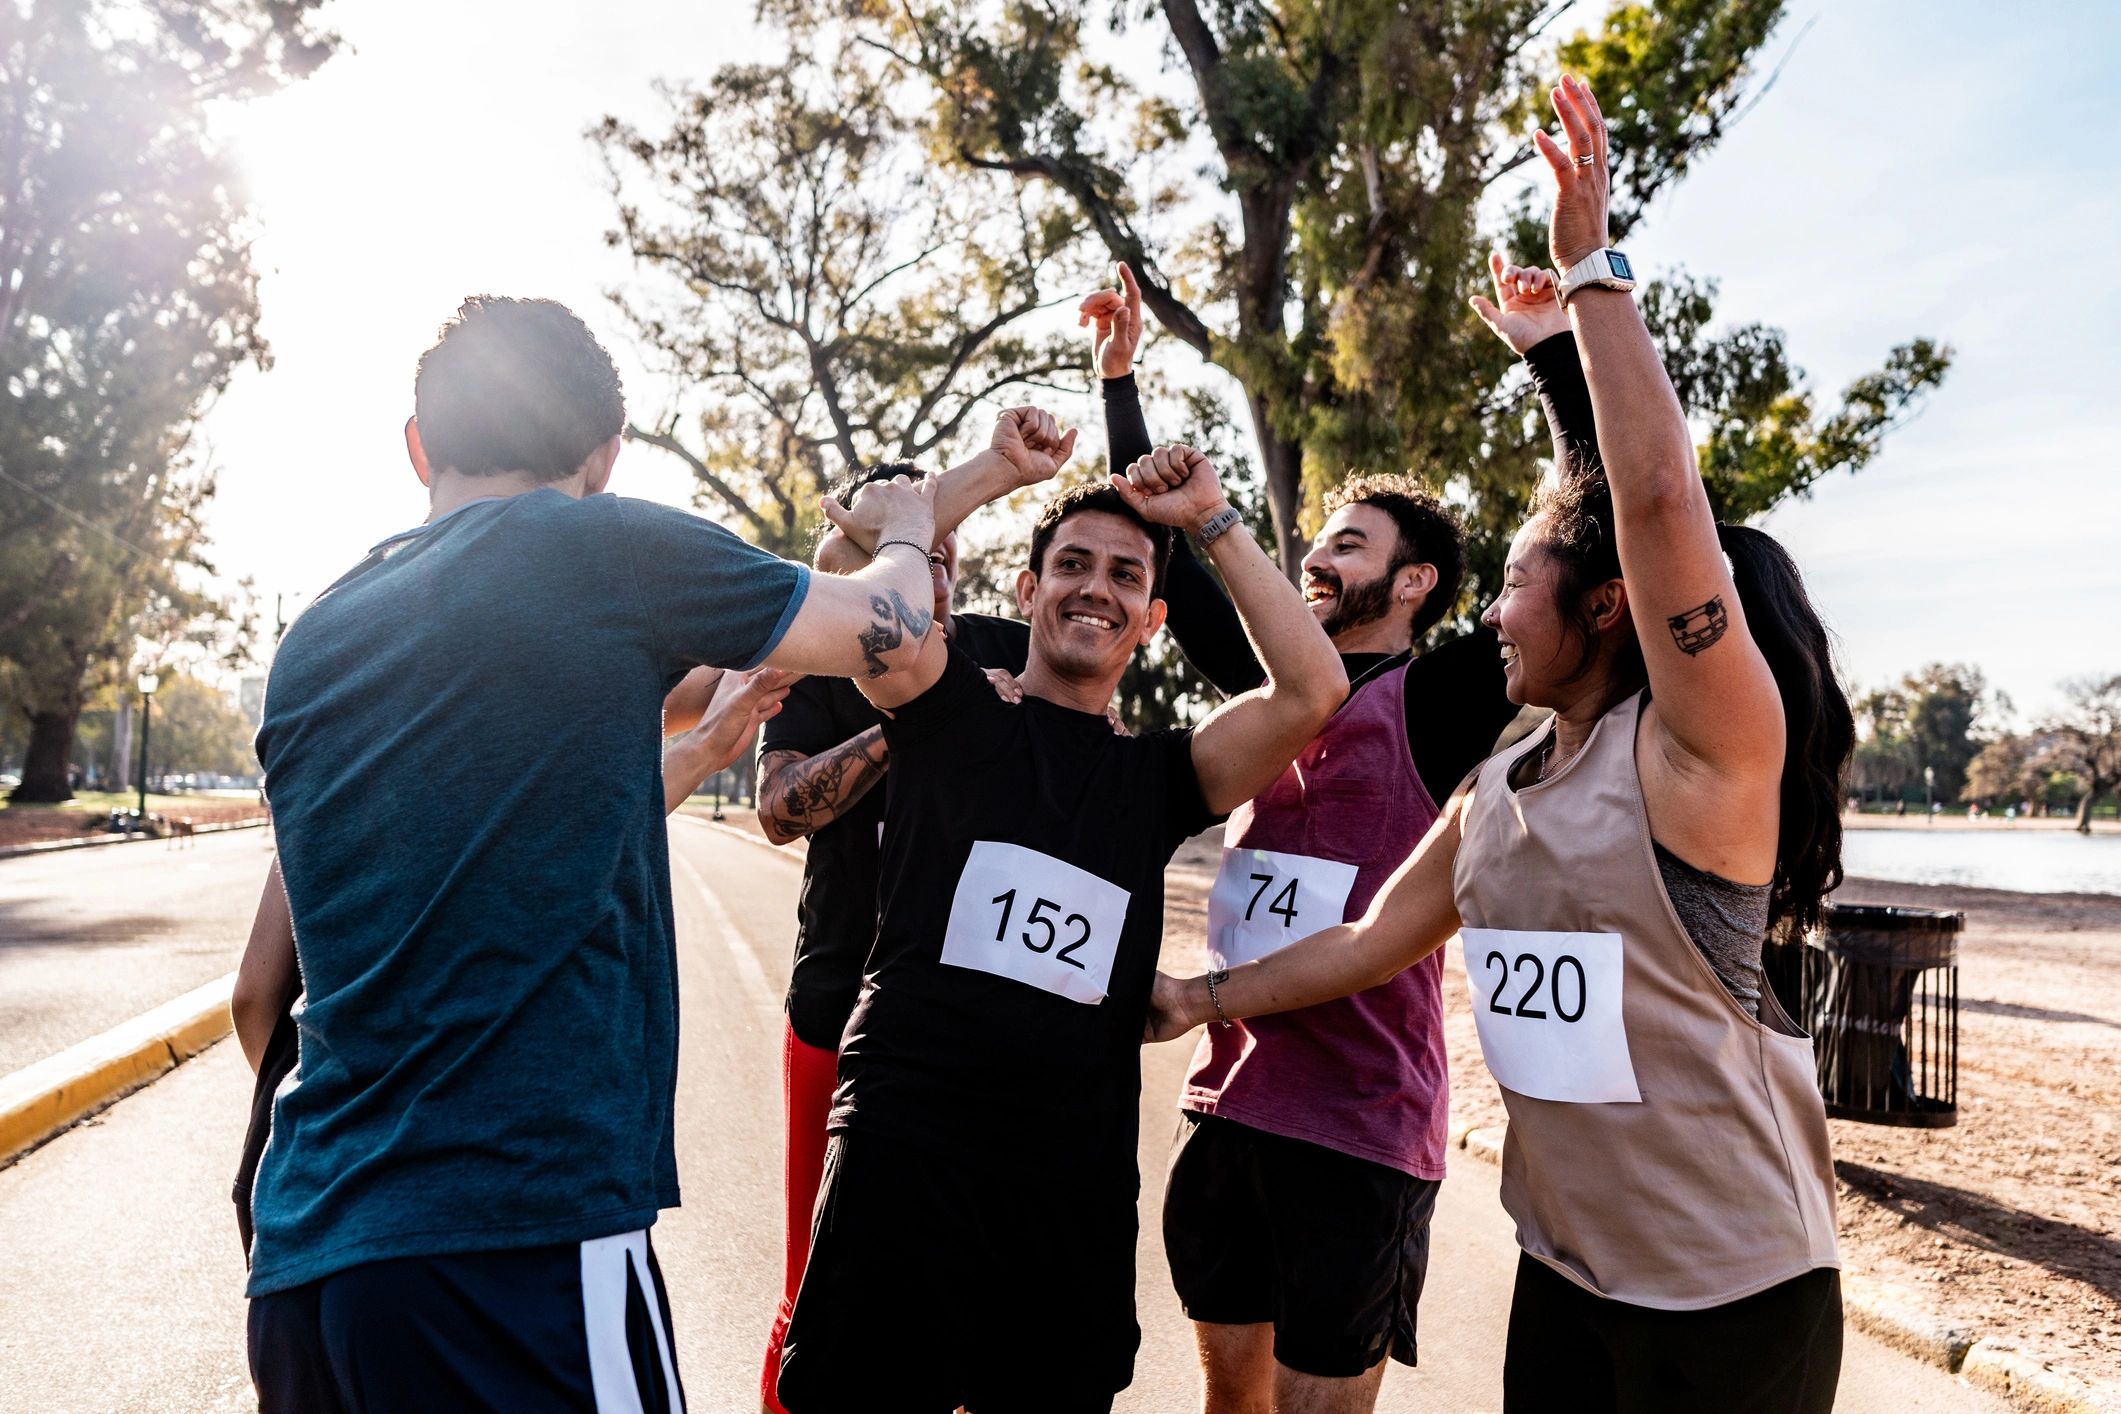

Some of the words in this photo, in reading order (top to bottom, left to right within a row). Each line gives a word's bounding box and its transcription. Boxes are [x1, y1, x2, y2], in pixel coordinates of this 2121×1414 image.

[991, 888, 1092, 970] 152
[1245, 873, 1299, 928] 74
[1485, 950, 1587, 1024] 220
